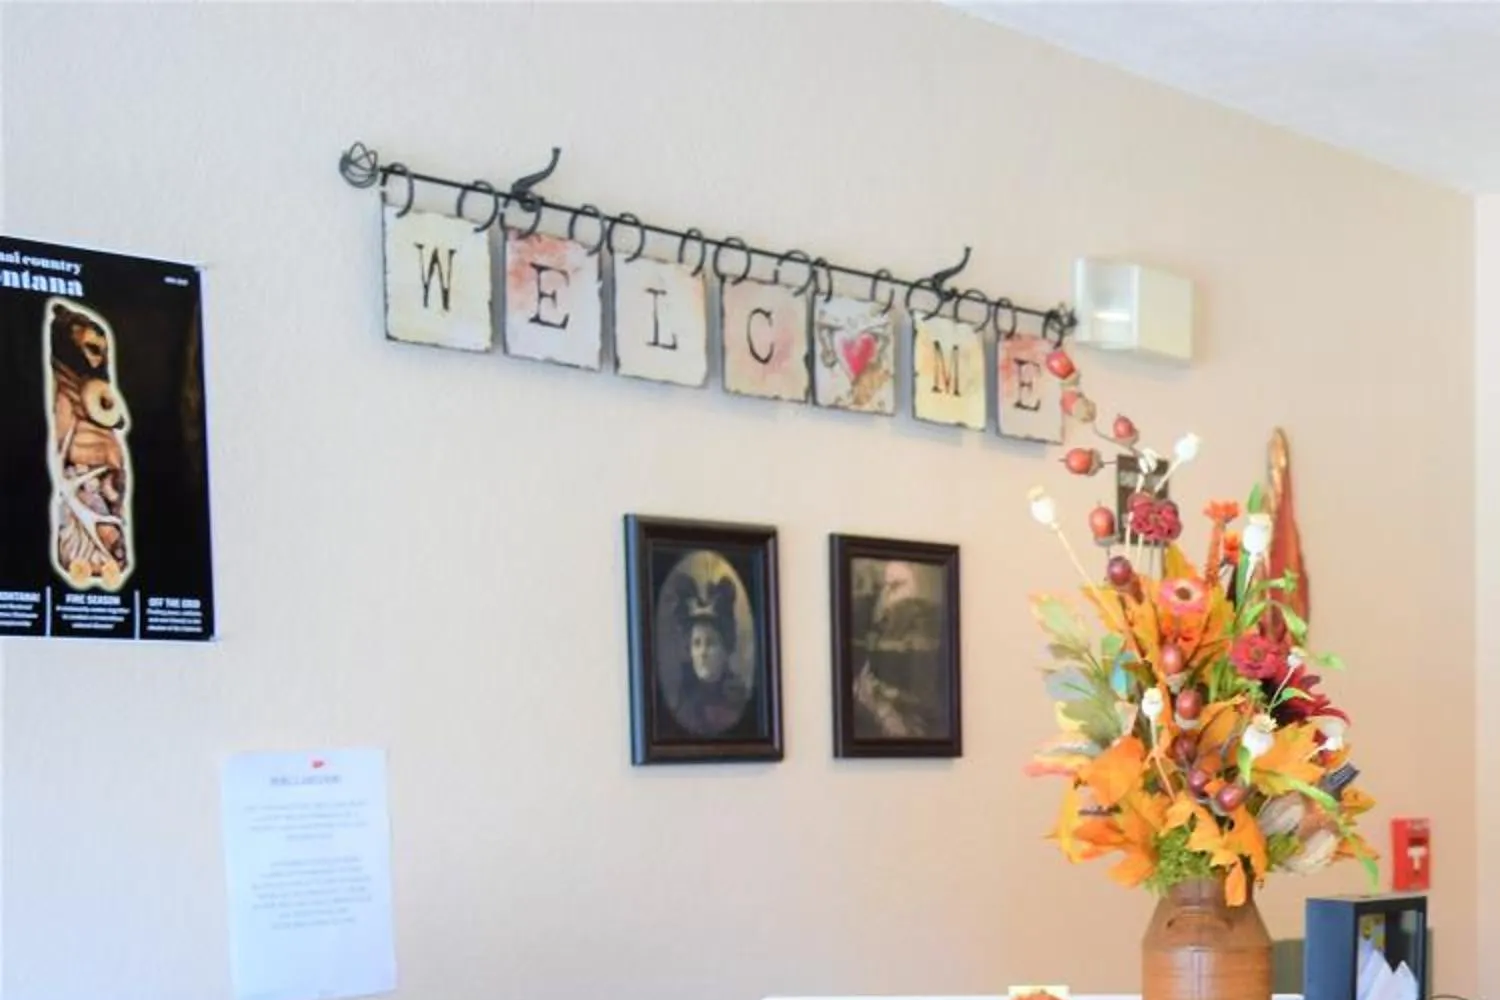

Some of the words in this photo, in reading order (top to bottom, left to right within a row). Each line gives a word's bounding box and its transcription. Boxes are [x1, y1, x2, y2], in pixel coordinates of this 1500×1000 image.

[21, 255, 82, 276] country
[0, 268, 84, 297] ntana
[413, 242, 1041, 411] WELCME
